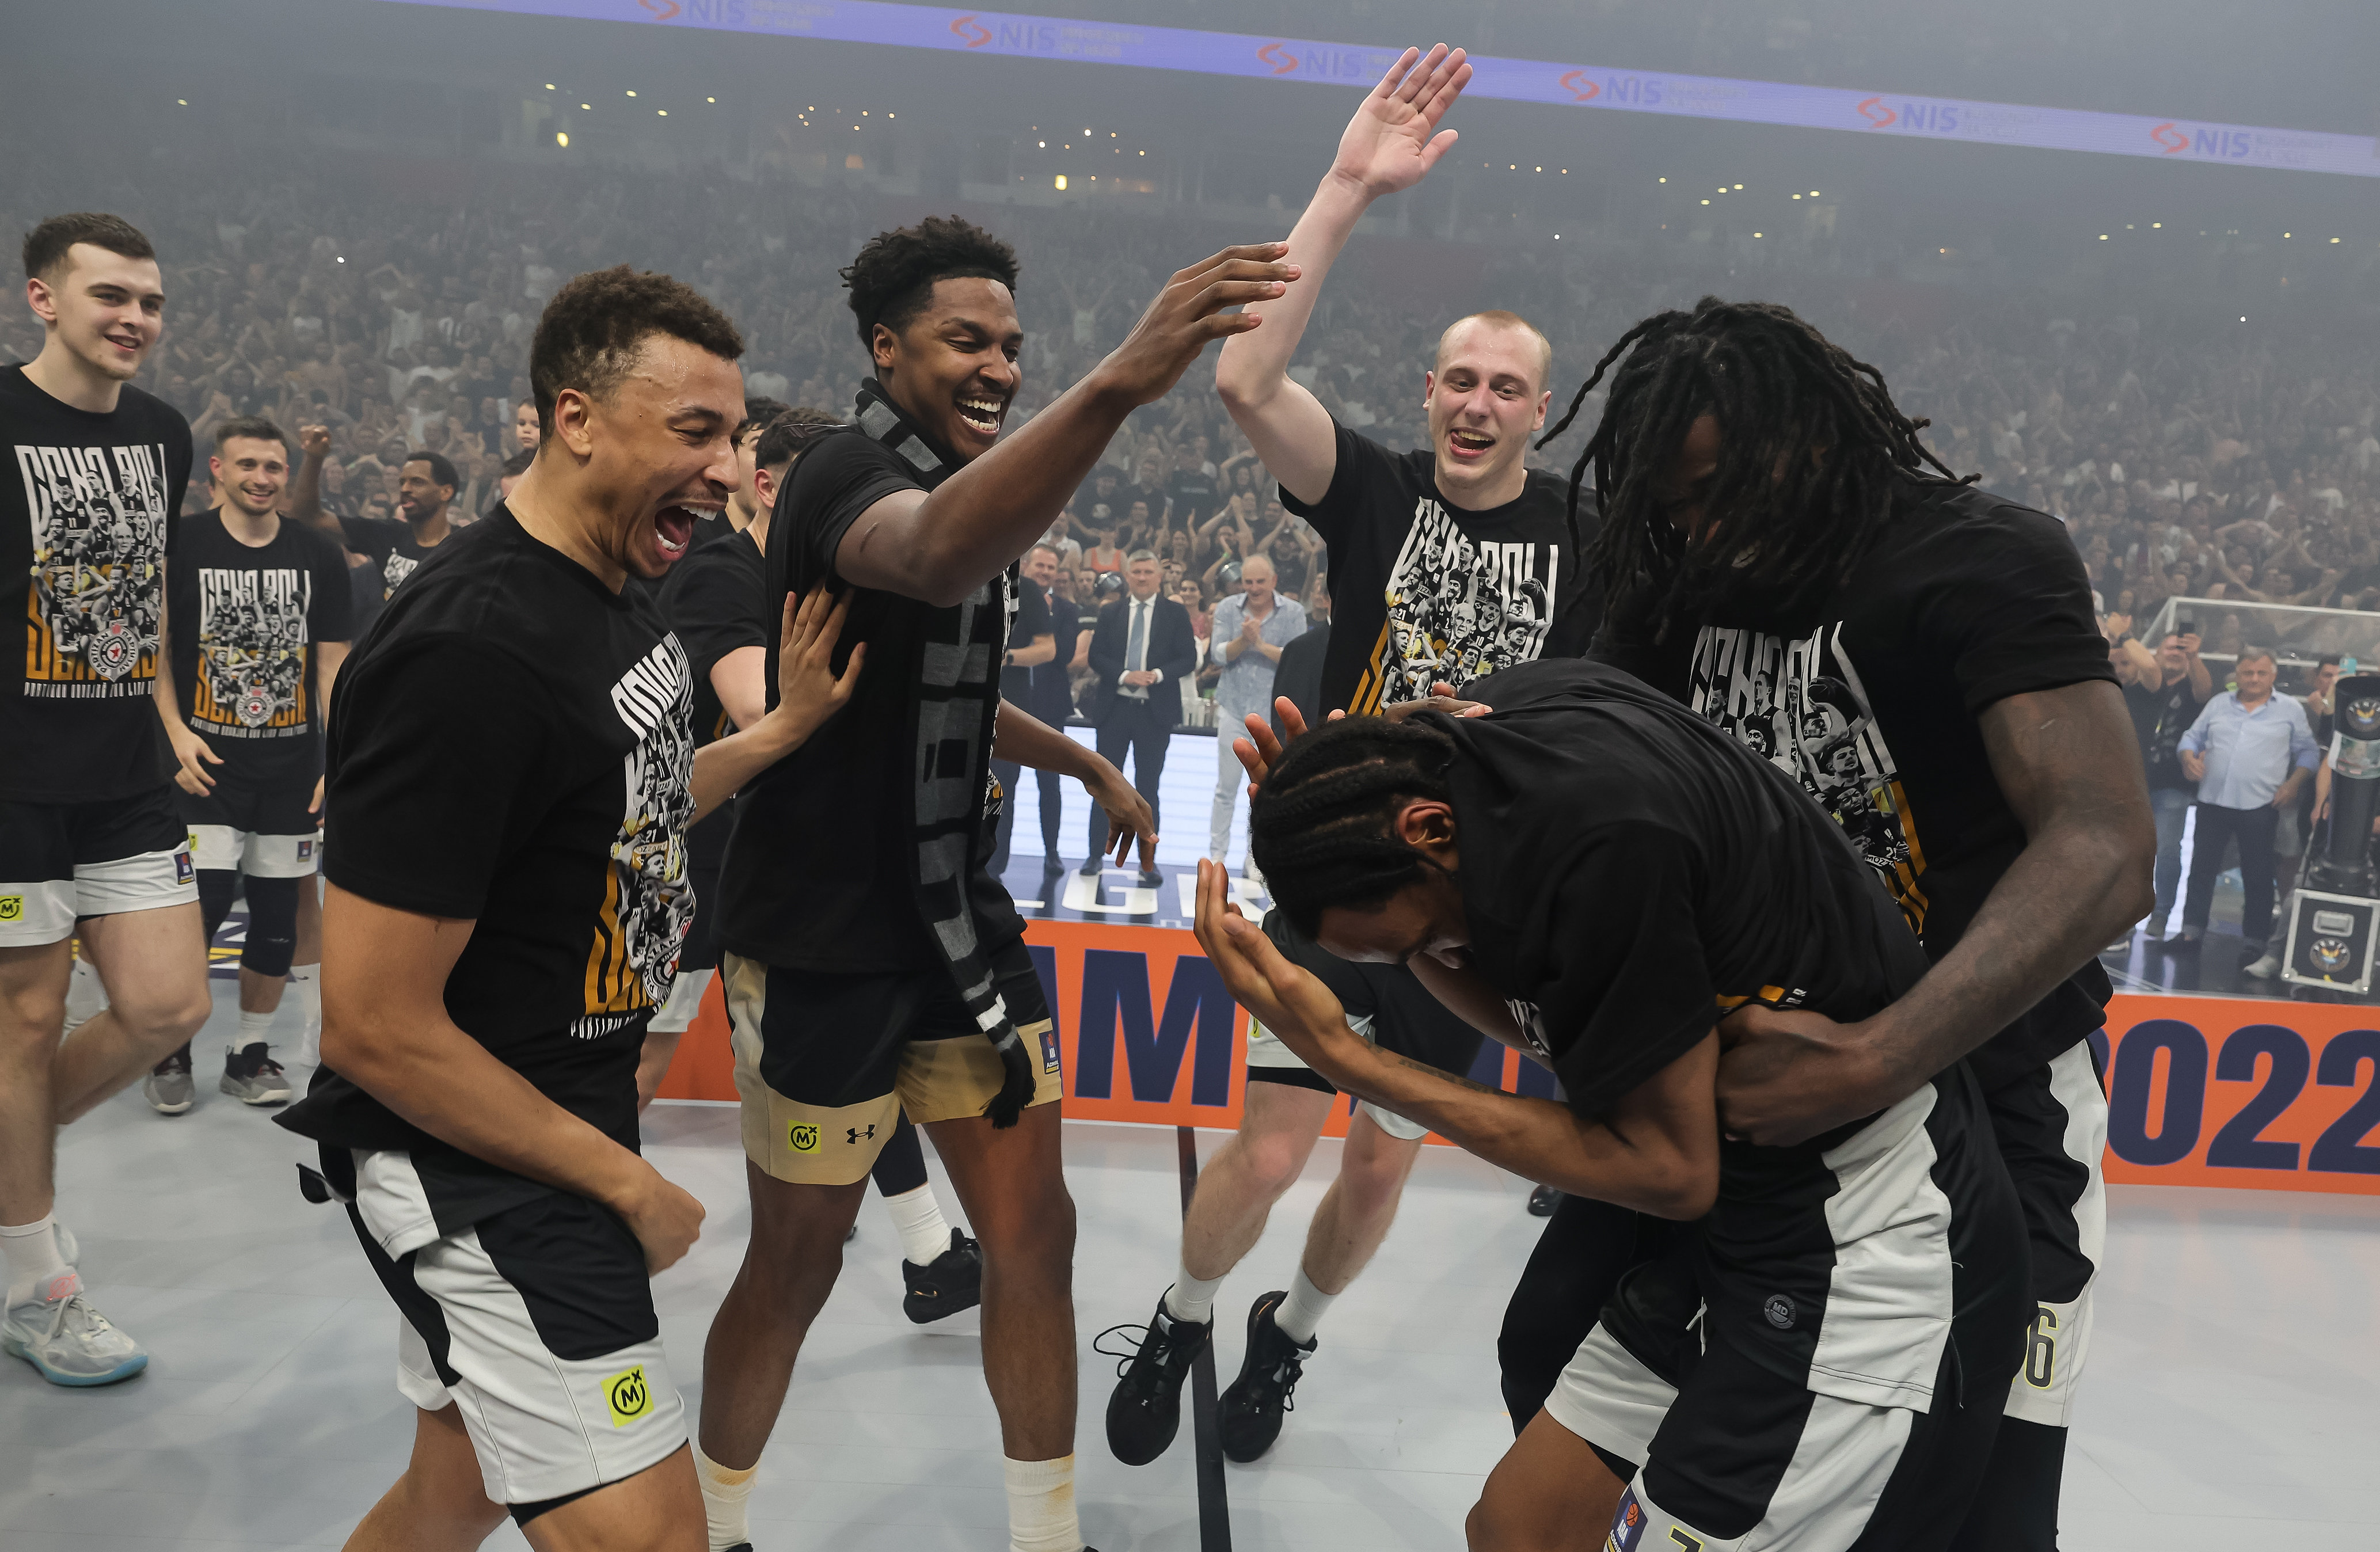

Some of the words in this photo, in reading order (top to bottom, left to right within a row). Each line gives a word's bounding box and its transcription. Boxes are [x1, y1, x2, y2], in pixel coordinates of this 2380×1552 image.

[687, 0, 745, 23] NIS
[999, 22, 1055, 51] NIS
[1305, 49, 1362, 77] NIS
[1607, 76, 1663, 105] NIS
[1902, 103, 1959, 132] NIS
[2194, 129, 2252, 158] NIS
